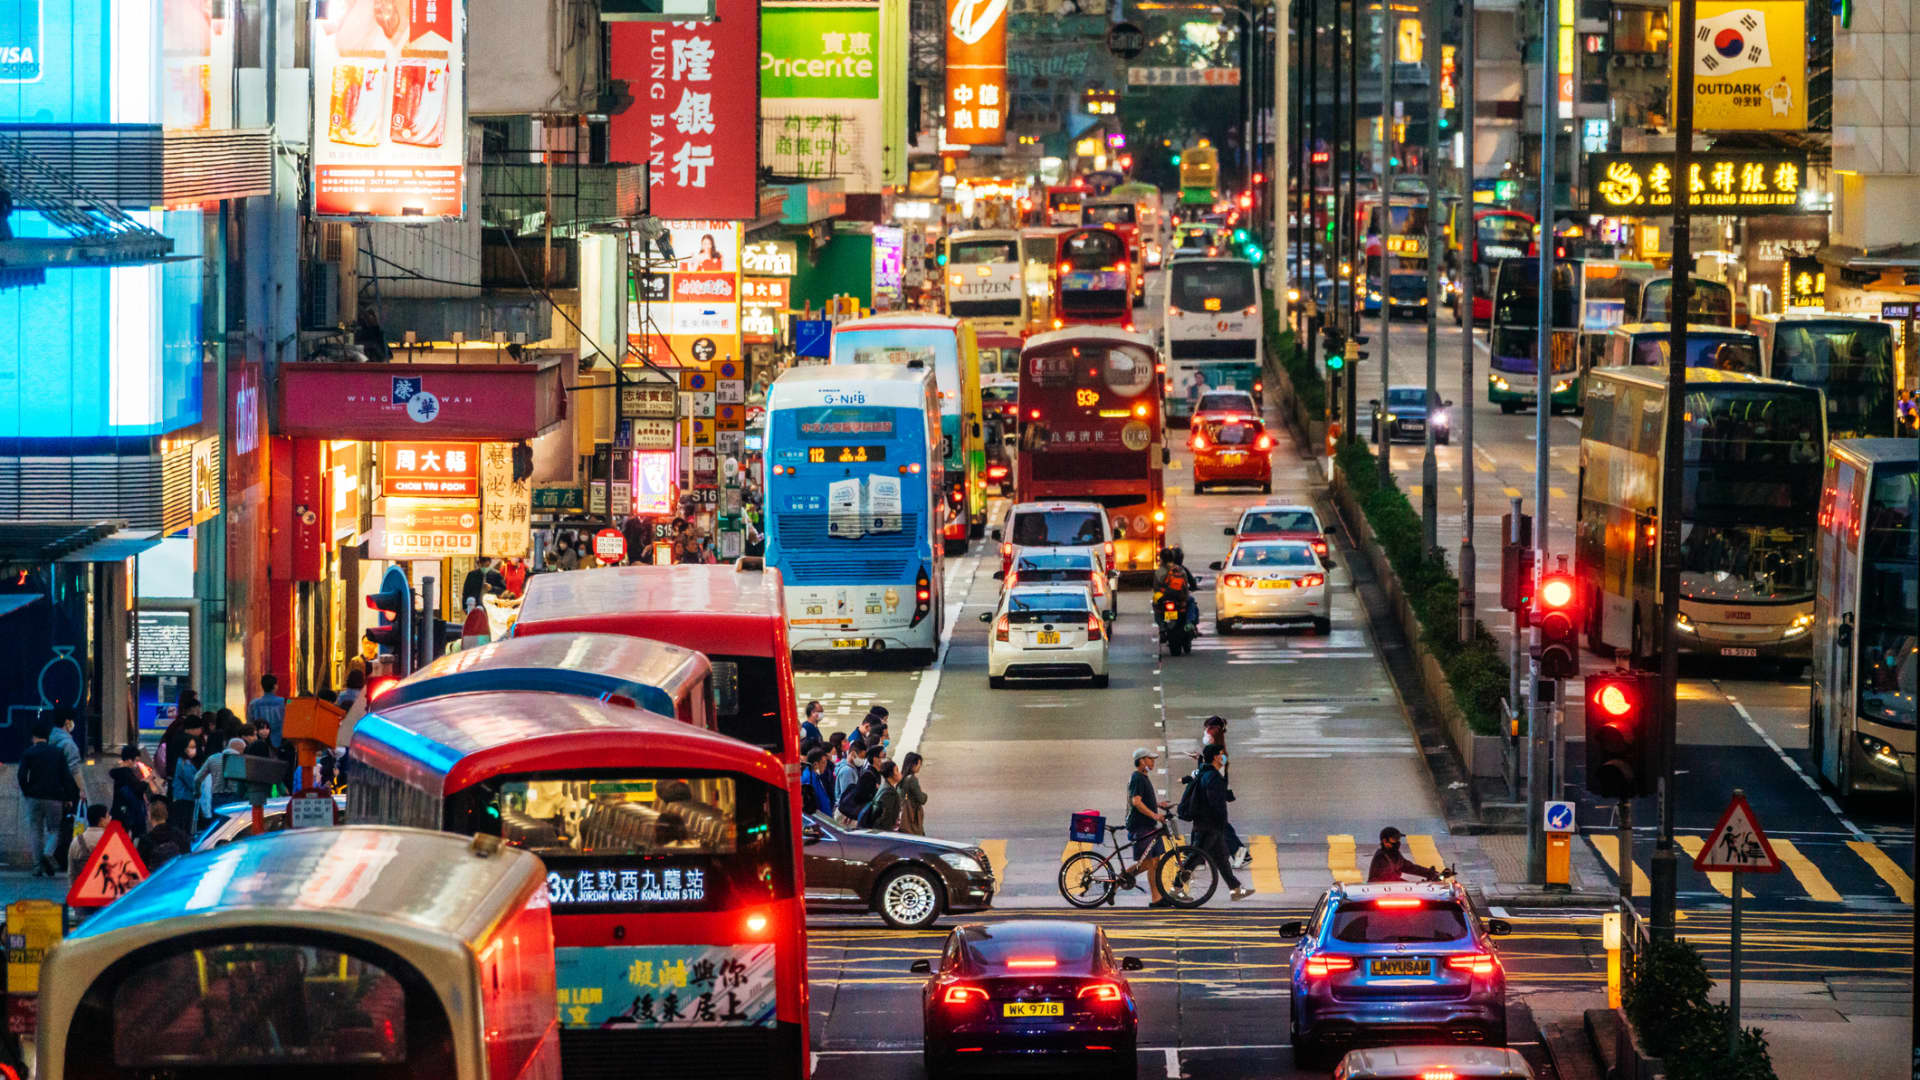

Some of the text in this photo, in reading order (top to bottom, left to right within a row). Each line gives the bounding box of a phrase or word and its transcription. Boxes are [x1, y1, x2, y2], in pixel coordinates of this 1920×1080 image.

[0, 46, 34, 64] ISA
[761, 52, 873, 78] Pricerite
[1697, 83, 1761, 95] OUTDARK
[650, 29, 665, 187] LUNG BANK
[670, 21, 716, 187] 隆銀行
[1650, 194, 1672, 205] LAO
[957, 282, 1012, 295] CITIZEN
[809, 448, 825, 462] 112
[395, 482, 422, 491] CHOW
[440, 482, 466, 491] FOOK
[692, 490, 717, 502] S16
[576, 868, 704, 890] 佐敦西九龍站
[577, 889, 609, 901] JORDAN
[641, 889, 681, 901] KOWLOON
[632, 993, 748, 1022] 後來居上
[1010, 1004, 1059, 1015] WK 9718
